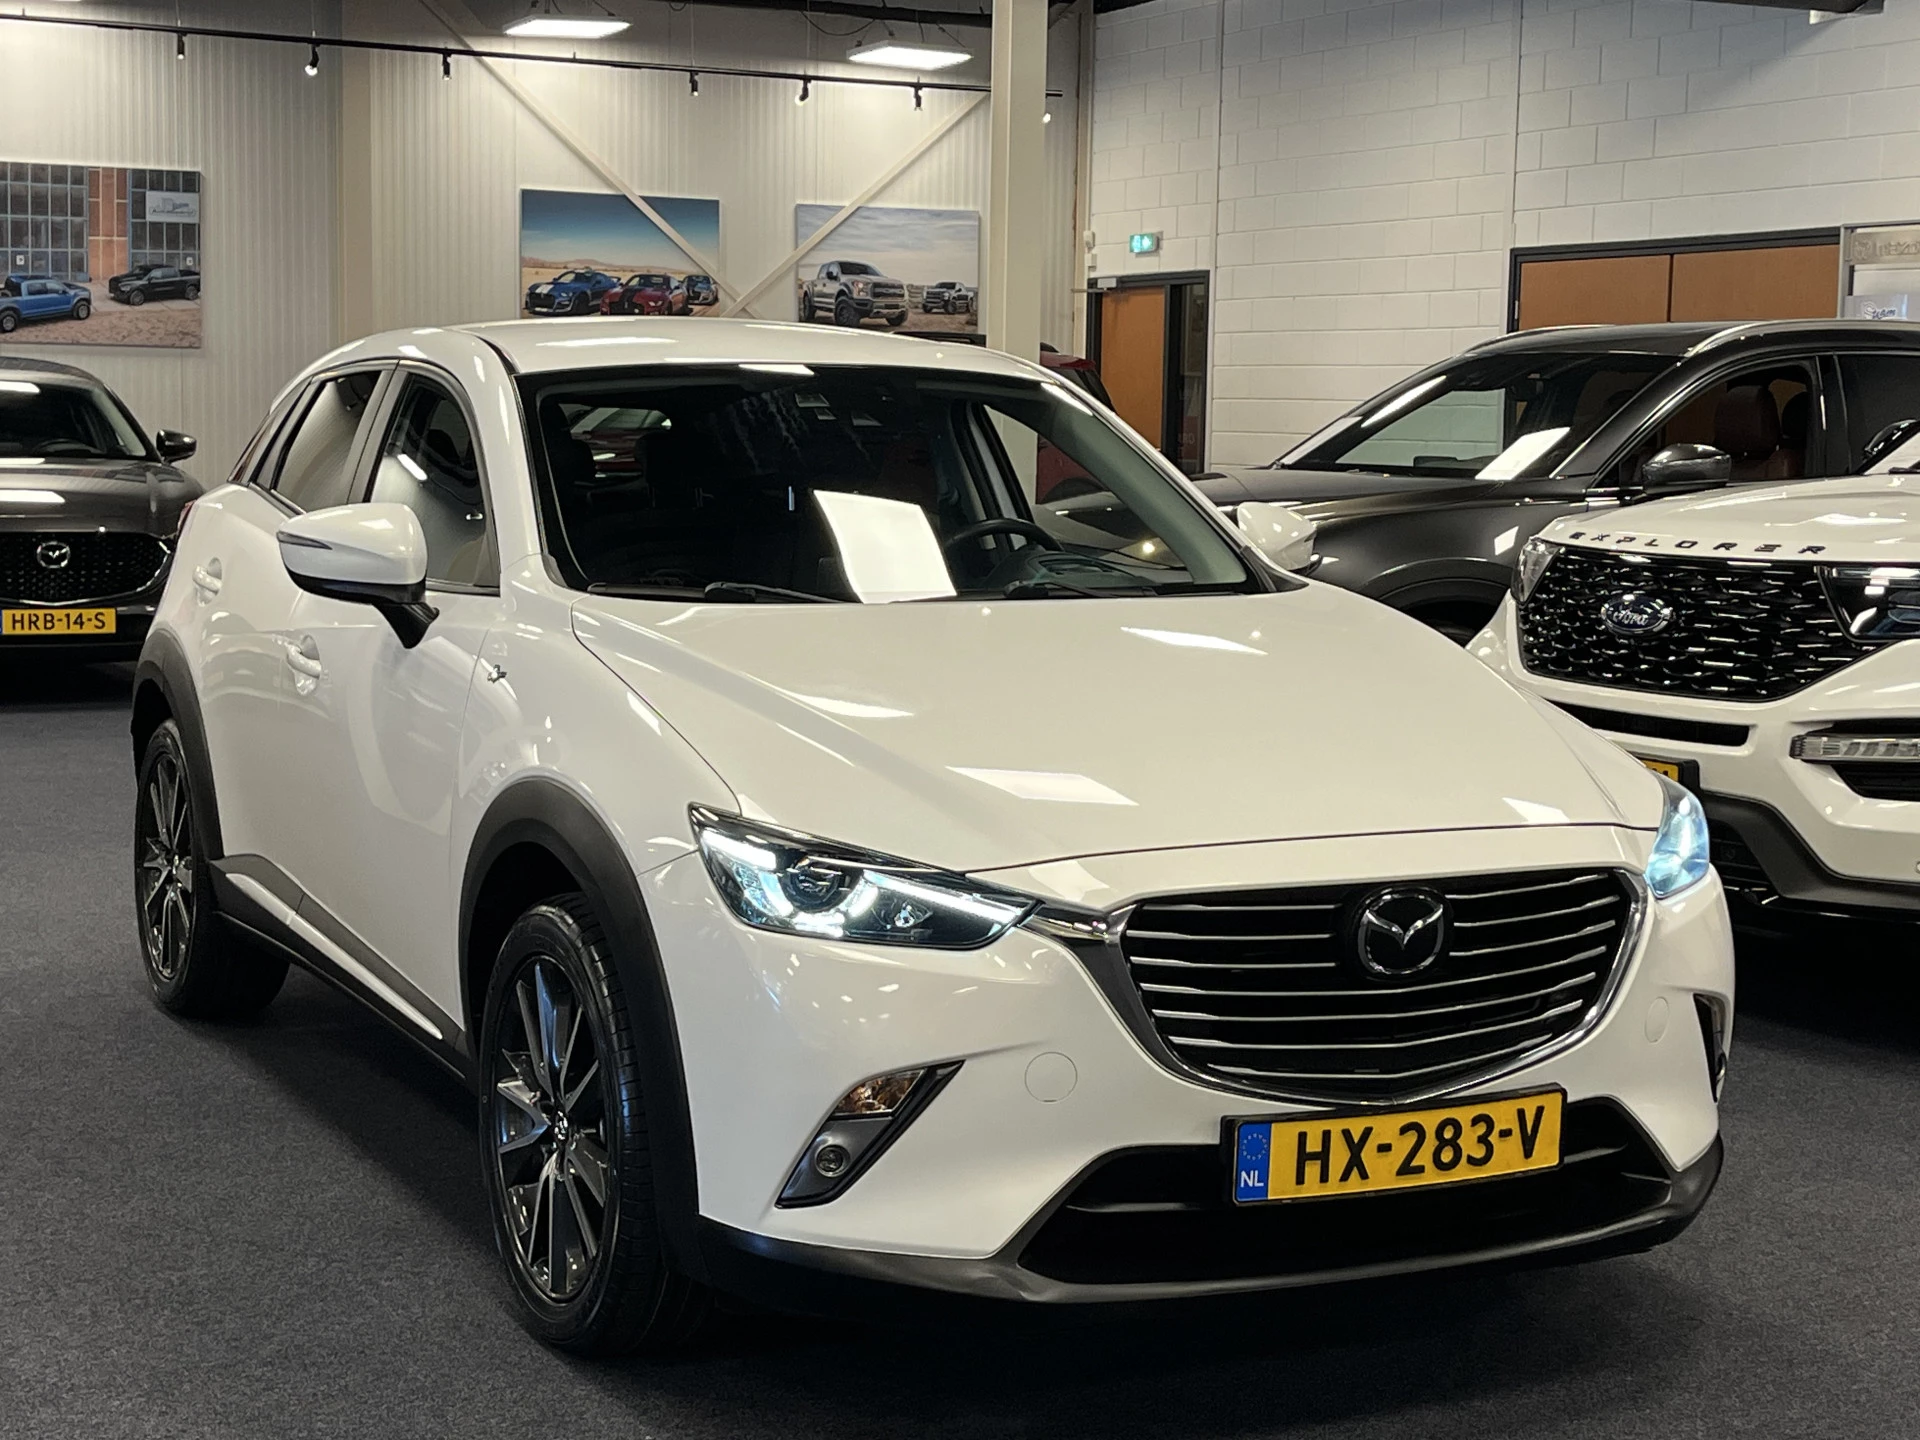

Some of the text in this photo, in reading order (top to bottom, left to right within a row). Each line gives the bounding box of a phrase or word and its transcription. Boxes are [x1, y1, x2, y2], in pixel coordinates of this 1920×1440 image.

[1569, 531, 1826, 555] EXPLORER
[11, 612, 106, 631] HRB-14-S
[1295, 1104, 1545, 1186] HX-283-V
[1240, 1170, 1264, 1188] NL
